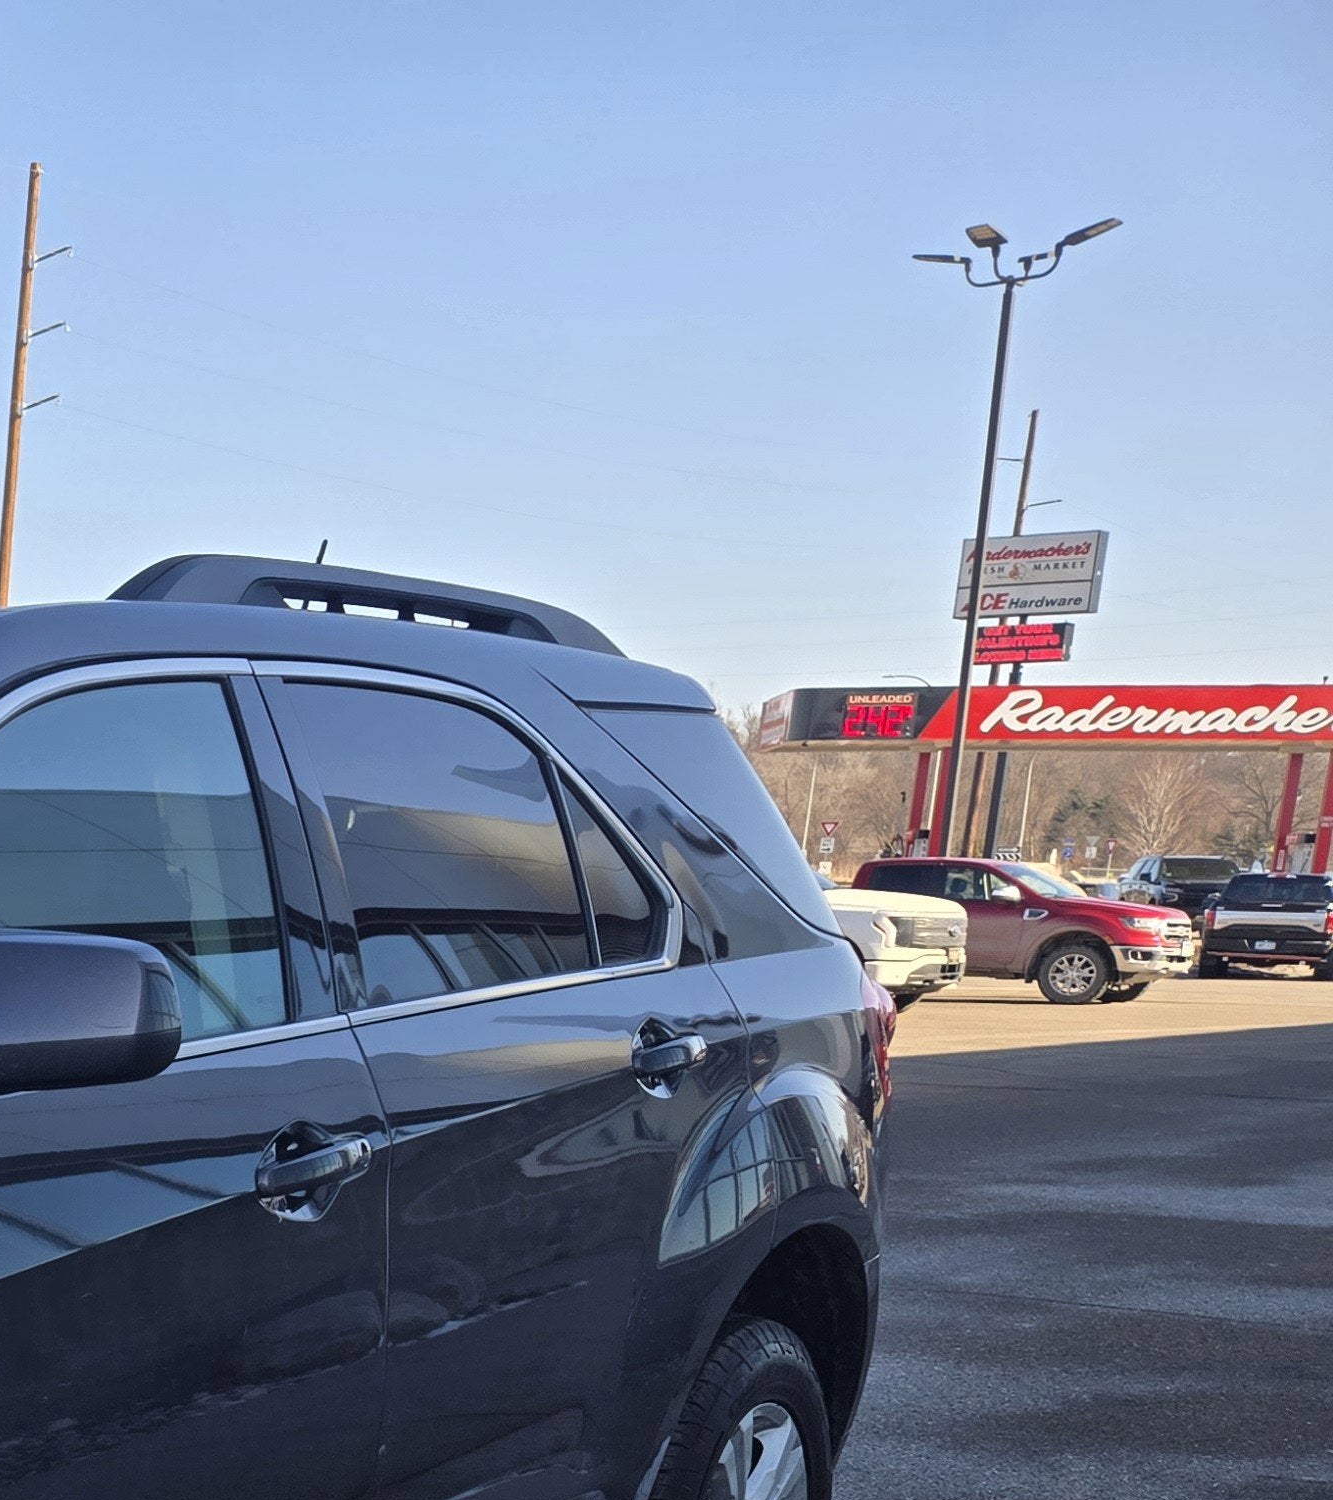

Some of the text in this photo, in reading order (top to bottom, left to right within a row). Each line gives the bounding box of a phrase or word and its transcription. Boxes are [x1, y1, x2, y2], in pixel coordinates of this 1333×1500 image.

[966, 541, 1092, 562] dermacher's
[1032, 561, 1086, 571] MARKET
[1008, 596, 1083, 609] Hardware
[974, 650, 1026, 662] LOWERS
[849, 694, 912, 704] UNLEADED
[979, 689, 1333, 734] Radermache
